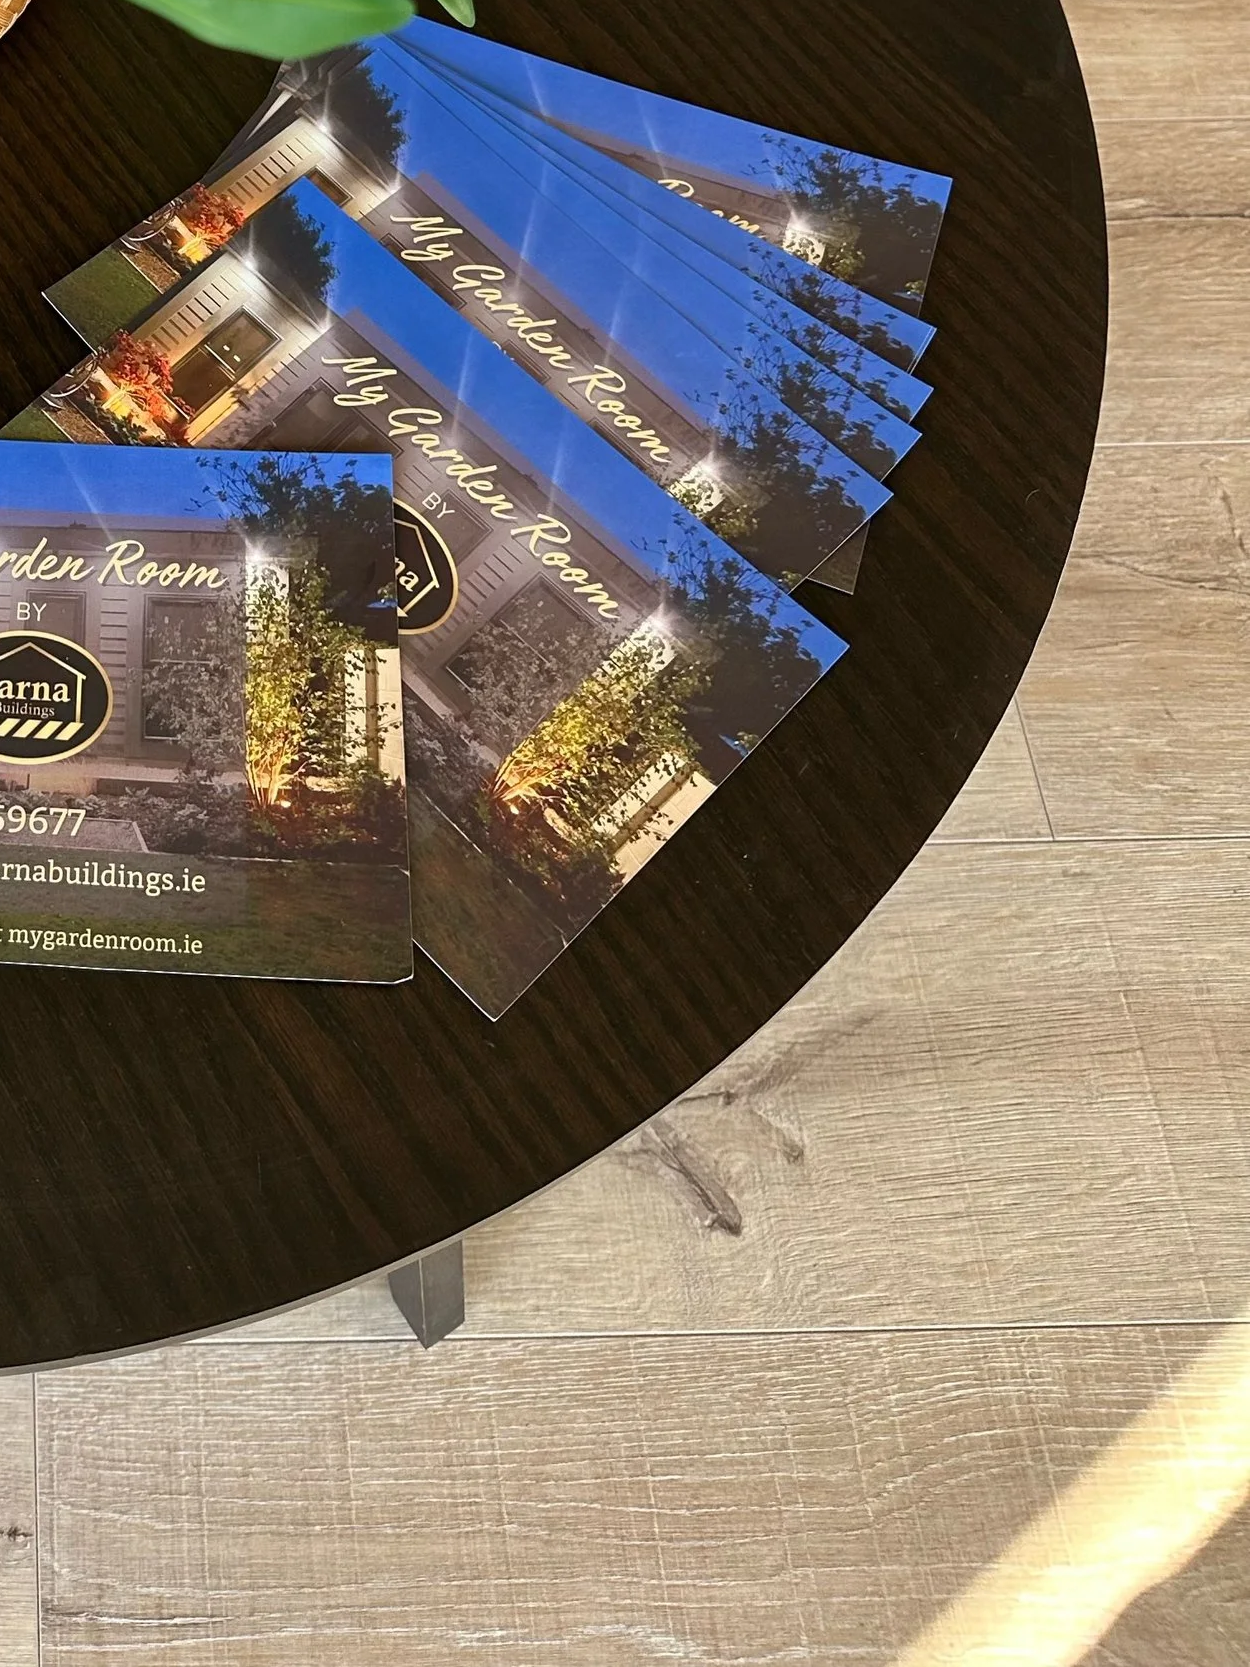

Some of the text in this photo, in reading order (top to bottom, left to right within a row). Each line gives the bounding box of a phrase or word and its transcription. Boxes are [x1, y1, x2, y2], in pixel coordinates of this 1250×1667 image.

[390, 214, 672, 465] My Garden Room
[320, 355, 621, 620] My Garden Room
[421, 490, 456, 520] BY
[96, 538, 229, 591] Room
[15, 601, 48, 622] BY
[7, 927, 204, 956] mygardenroom.ie
